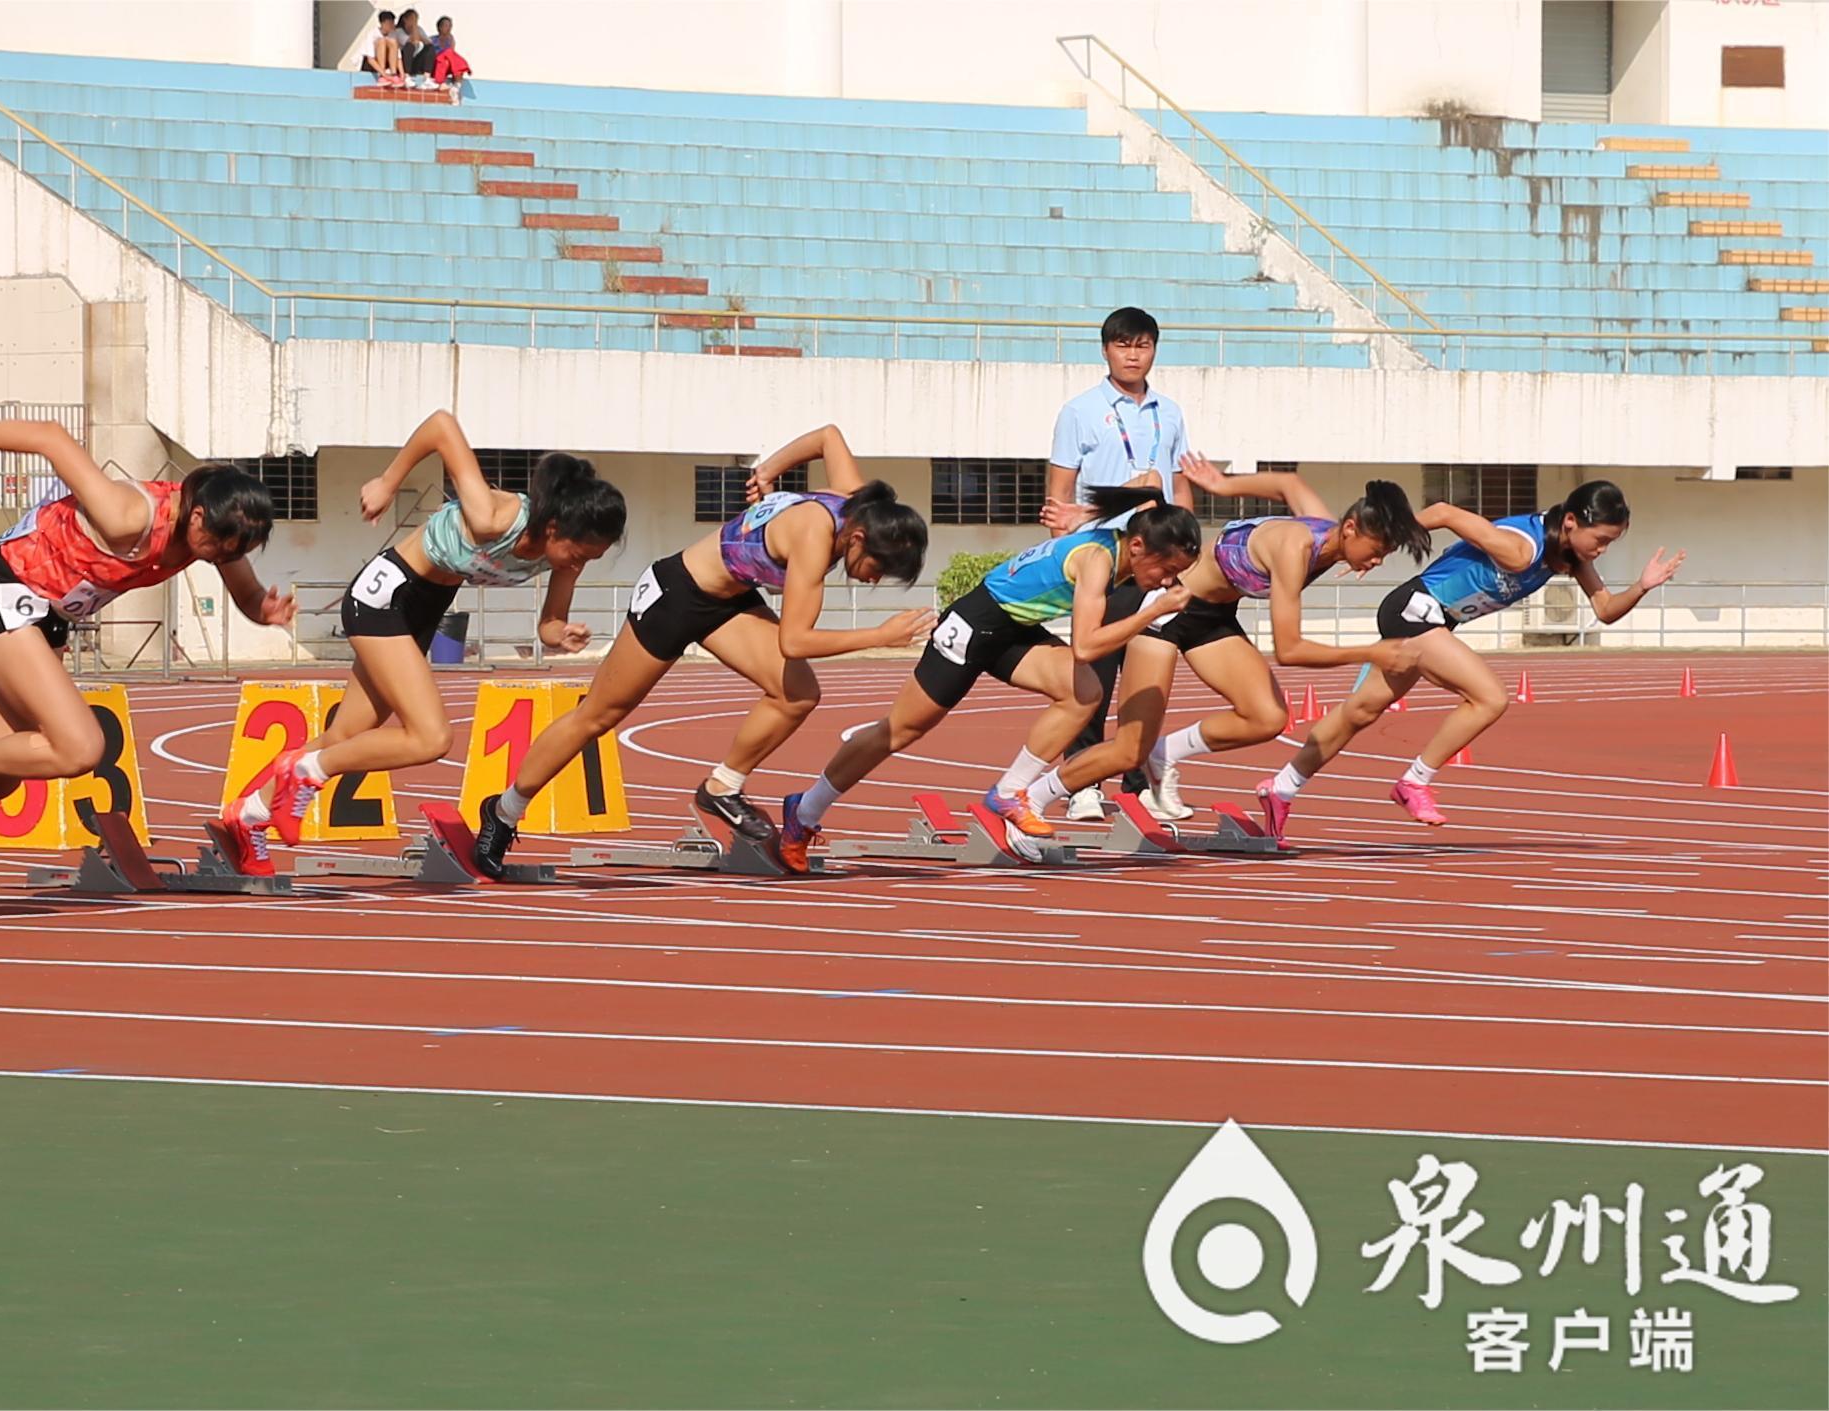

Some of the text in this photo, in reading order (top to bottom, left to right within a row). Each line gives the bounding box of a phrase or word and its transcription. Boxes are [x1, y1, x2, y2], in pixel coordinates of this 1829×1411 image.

[15, 595, 34, 616] 6
[366, 570, 388, 595] 5
[941, 626, 958, 650] 3
[73, 705, 132, 836] 3
[239, 700, 308, 798] 2
[484, 699, 533, 820] 1
